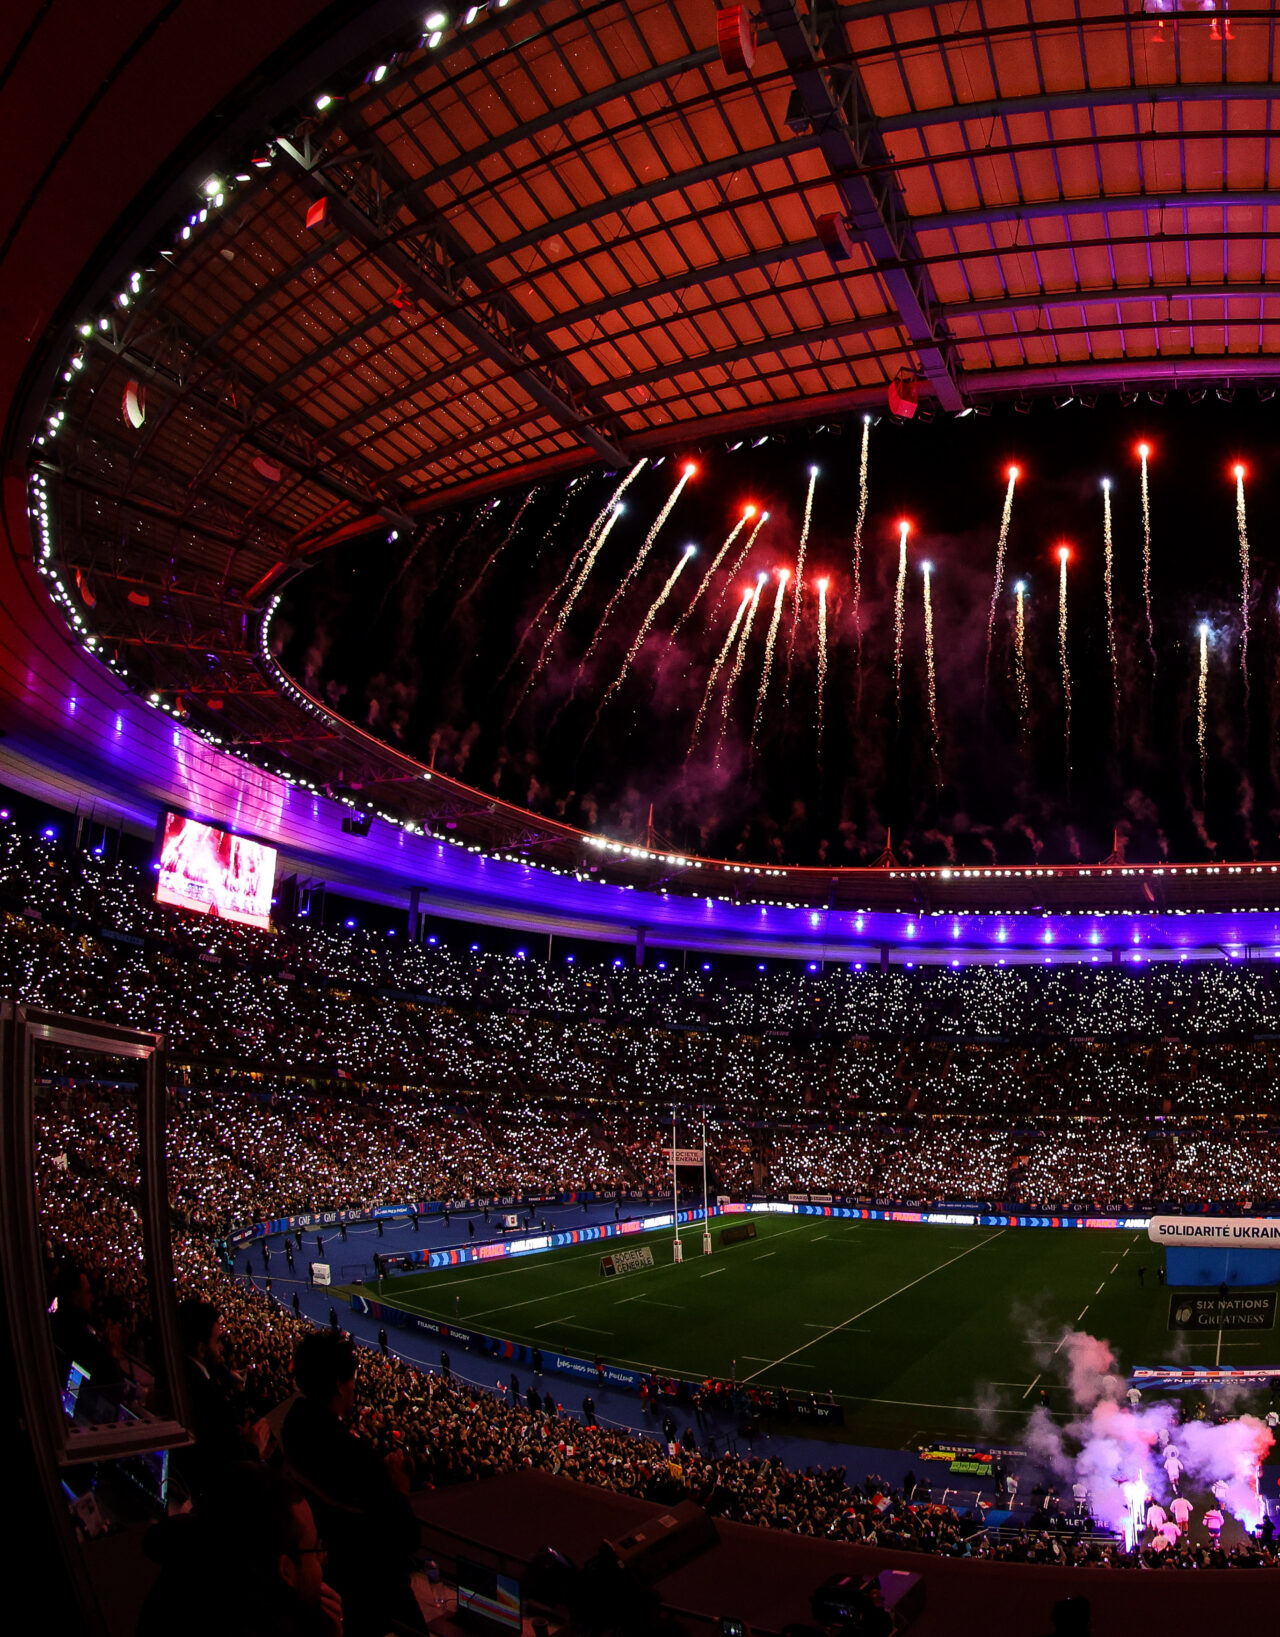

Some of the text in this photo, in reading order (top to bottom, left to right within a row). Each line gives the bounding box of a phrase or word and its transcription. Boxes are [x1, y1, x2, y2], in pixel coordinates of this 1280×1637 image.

[1106, 1204, 1122, 1212] GMF
[1159, 1224, 1230, 1237] SOLIDARITÉ
[1196, 1299, 1270, 1310] SIX NATIONS
[417, 1320, 471, 1342] FRANCE RUGBY
[797, 1405, 830, 1417] RUBY
